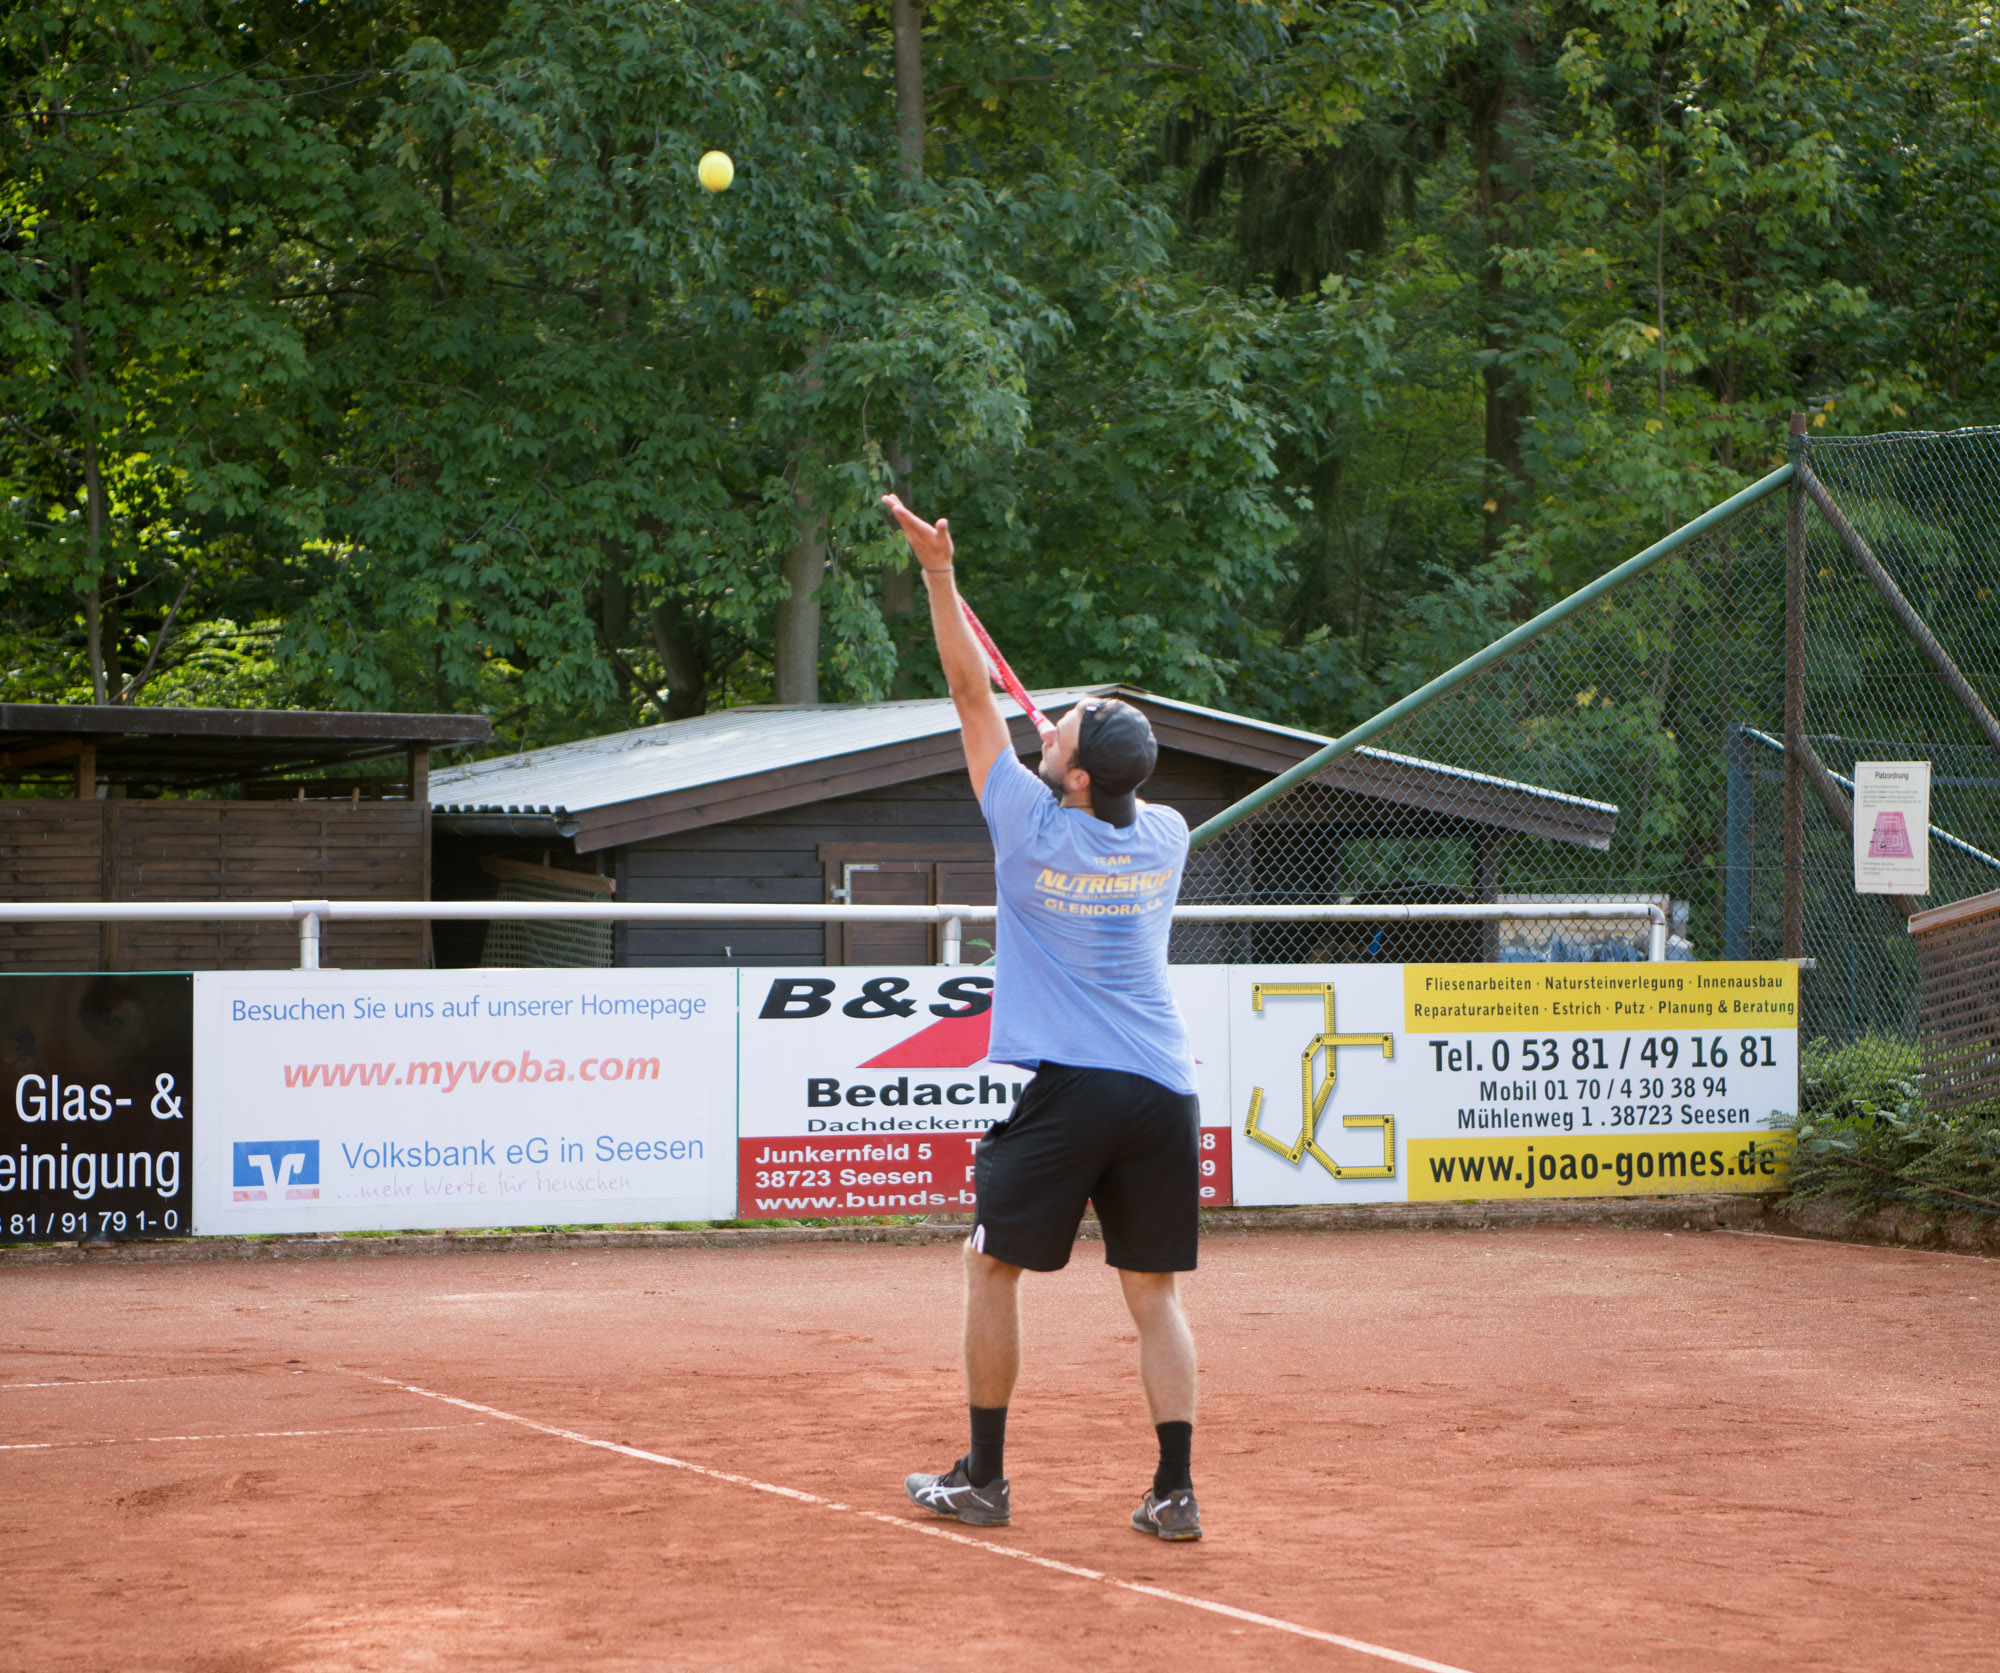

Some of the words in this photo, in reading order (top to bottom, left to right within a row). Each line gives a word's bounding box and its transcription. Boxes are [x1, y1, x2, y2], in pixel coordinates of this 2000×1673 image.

[1875, 771, 1909, 780] Platzordnung
[1093, 855, 1131, 866] TEAM
[1036, 868, 1173, 893] NUTRISHOP
[1146, 897, 1163, 911] CA
[1426, 977, 1531, 990] Fliesenarbeiten
[1546, 976, 1683, 991] Natursteinverlegung
[1698, 975, 1782, 988] Innenausbau
[233, 998, 344, 1021] Besuchen
[354, 997, 386, 1019] Sie
[395, 1002, 434, 1018] uns
[442, 995, 480, 1017] auf
[489, 1000, 573, 1016] unserer
[582, 995, 706, 1020] Homepage
[1415, 1003, 1538, 1019] Reparaturarbeiten
[1553, 1002, 1600, 1015] Estrich
[1615, 1001, 1644, 1014] Putz
[1659, 1001, 1712, 1015] Planung
[1718, 1000, 1727, 1013] &
[1734, 1000, 1794, 1015] Beratung
[1429, 1040, 1482, 1071] Tel.
[1492, 1039, 1509, 1071] 0
[1522, 1039, 1559, 1071] 53
[1572, 1038, 1608, 1070] 81
[1620, 1037, 1631, 1069] /
[1641, 1037, 1678, 1068] 49
[1692, 1036, 1728, 1068] 16
[1740, 1036, 1776, 1067] 81
[284, 1051, 660, 1093] www.myvoba.com
[16, 1074, 133, 1122] Glas-
[151, 1073, 184, 1119] &
[1481, 1081, 1536, 1101] Mobil
[1545, 1080, 1568, 1100] 01
[1577, 1079, 1600, 1099] 70
[1621, 1079, 1632, 1098] 4
[1640, 1078, 1663, 1099] 30
[1671, 1077, 1695, 1098] 38
[1703, 1077, 1726, 1097] 94
[1458, 1108, 1573, 1131] Mühlenweg
[1681, 1104, 1749, 1124] Seesen
[342, 1139, 495, 1168] Volksbank
[507, 1137, 548, 1164] eG
[561, 1137, 583, 1162] in
[596, 1136, 702, 1161] Seesen
[755, 1144, 909, 1164] Junkernfeld
[918, 1143, 932, 1160] 5
[1429, 1141, 1776, 1188] www.joao-gomes.de
[756, 1170, 831, 1188] 38723
[840, 1169, 932, 1186] Seesen
[10, 1214, 36, 1235] 81
[62, 1212, 88, 1233] 91
[99, 1211, 128, 1232] 79
